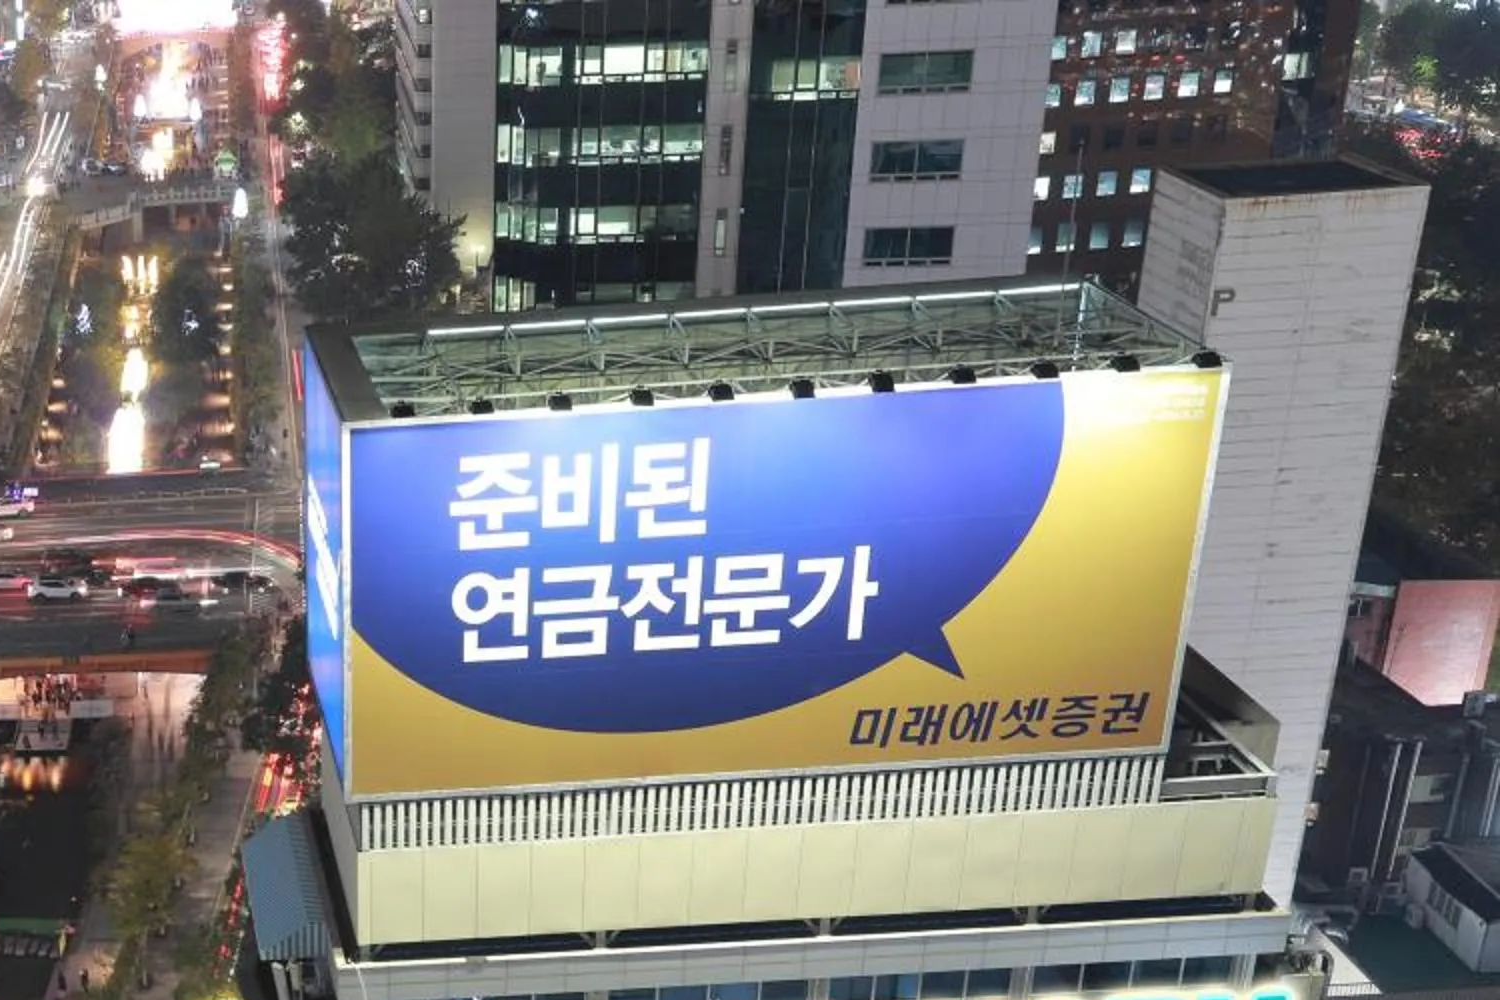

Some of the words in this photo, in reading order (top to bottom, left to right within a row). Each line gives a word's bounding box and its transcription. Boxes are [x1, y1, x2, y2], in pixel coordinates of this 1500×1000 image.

[449, 437, 711, 551] 준비된
[451, 544, 879, 663] 연금전문가
[849, 692, 1150, 749] 미래에셋증권
